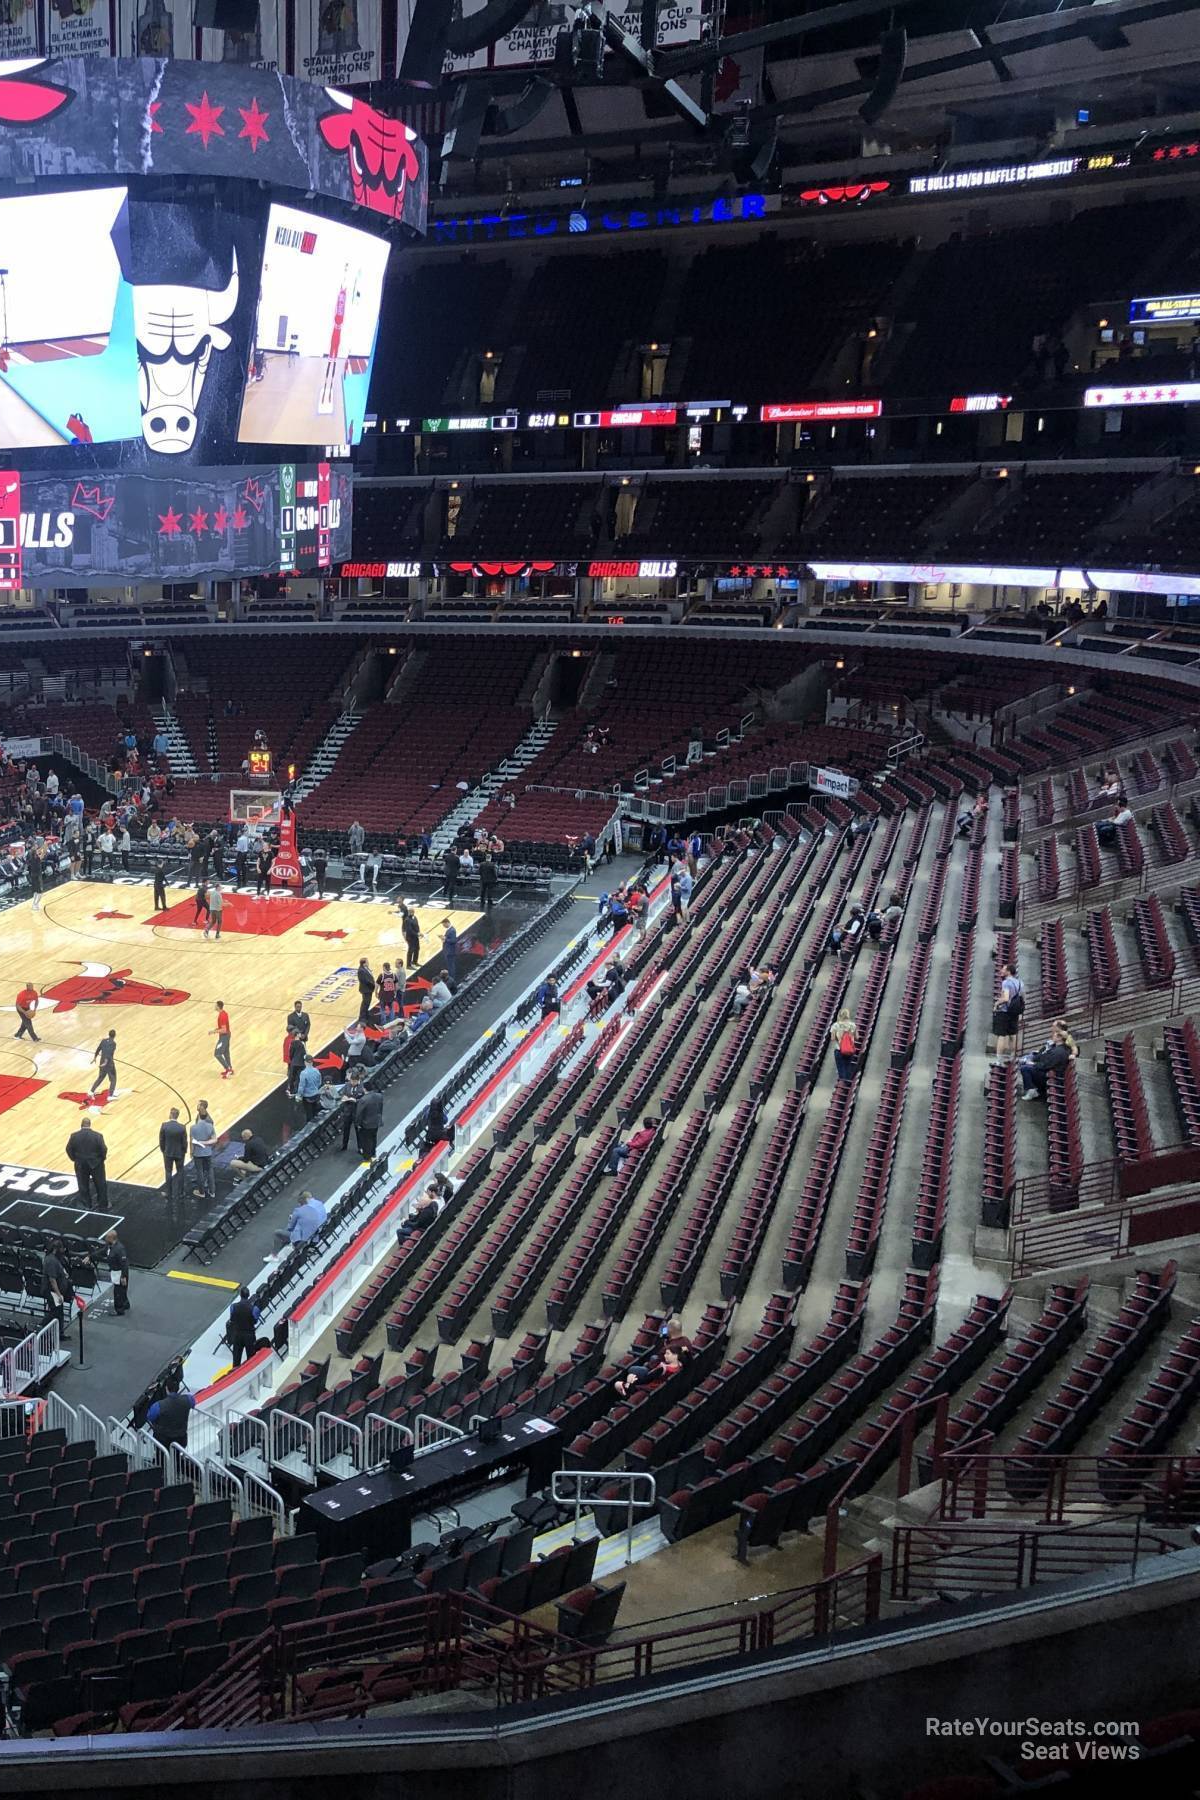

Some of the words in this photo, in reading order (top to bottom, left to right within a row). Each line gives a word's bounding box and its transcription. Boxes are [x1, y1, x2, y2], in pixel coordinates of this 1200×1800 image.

[60, 17, 93, 30] CHICAGO
[52, 28, 103, 42] BLACKHAWKS
[504, 25, 553, 41] STANLEY
[46, 42, 78, 54] CENTRAL
[79, 37, 109, 50] DIVISION
[508, 38, 557, 51] CHAMPIO
[302, 52, 347, 67] STANLEY
[352, 51, 375, 62] CUP
[529, 47, 555, 60] 2013
[308, 61, 370, 77] CHAMPIONS
[328, 74, 351, 84] 1961
[910, 178, 926, 193] THE
[927, 175, 955, 191] BULLS
[956, 171, 983, 188] 50/50
[984, 168, 1016, 185] RAFFLE
[1016, 166, 1026, 181] IS
[856, 405, 874, 414] CLUB
[966, 398, 986, 411] WITH
[986, 396, 997, 410] US
[20, 512, 75, 548] ULLS
[341, 563, 386, 577] CHICAGO
[386, 563, 420, 577] BULLS
[588, 562, 638, 577] CHICAGO
[639, 561, 676, 577] BULLS
[253, 761, 268, 772] 24
[275, 867, 294, 877] KIA
[300, 976, 339, 1002] UNITED
[320, 978, 360, 1003] CENTER
